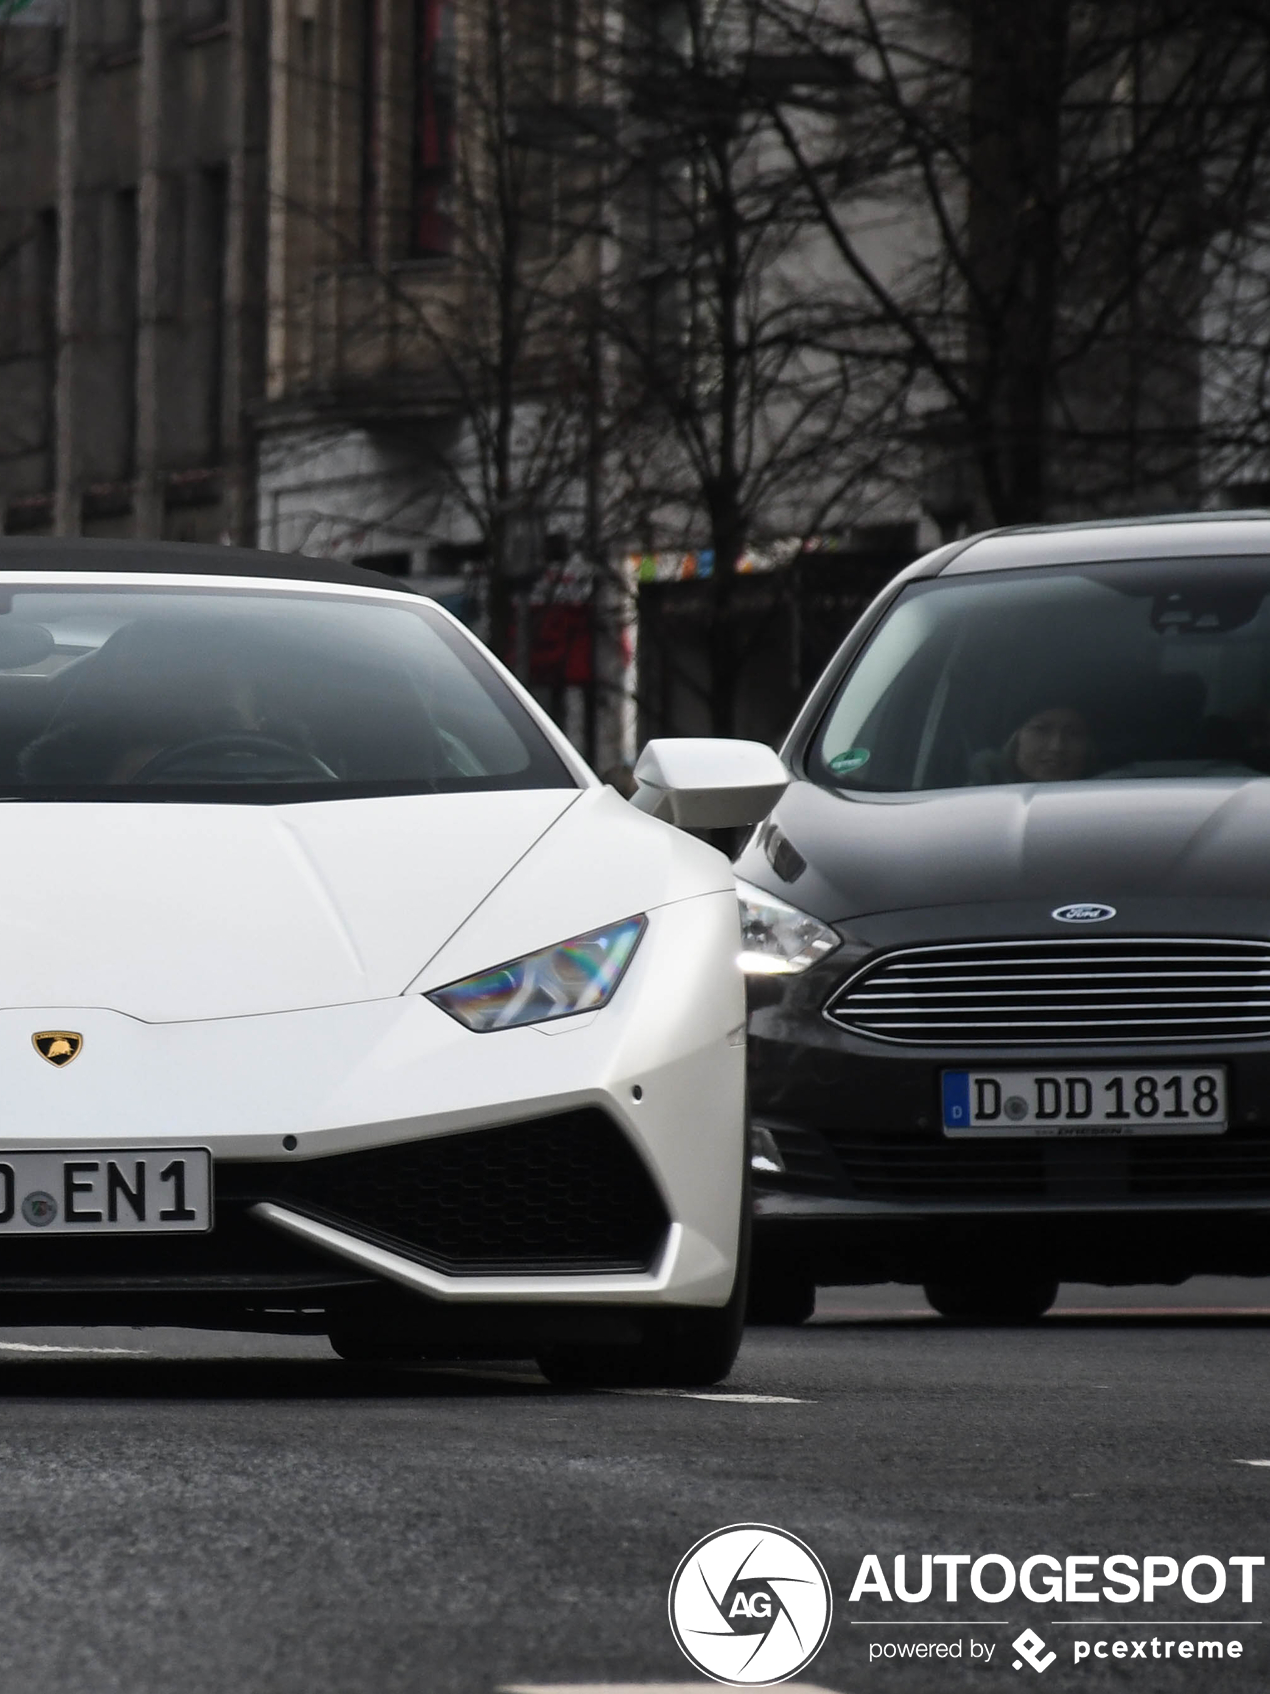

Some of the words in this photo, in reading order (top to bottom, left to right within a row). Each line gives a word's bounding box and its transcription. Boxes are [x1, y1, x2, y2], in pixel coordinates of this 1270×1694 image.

[1065, 908, 1101, 919] Ford
[974, 1078, 1002, 1120] D
[1104, 1075, 1219, 1119] 1818
